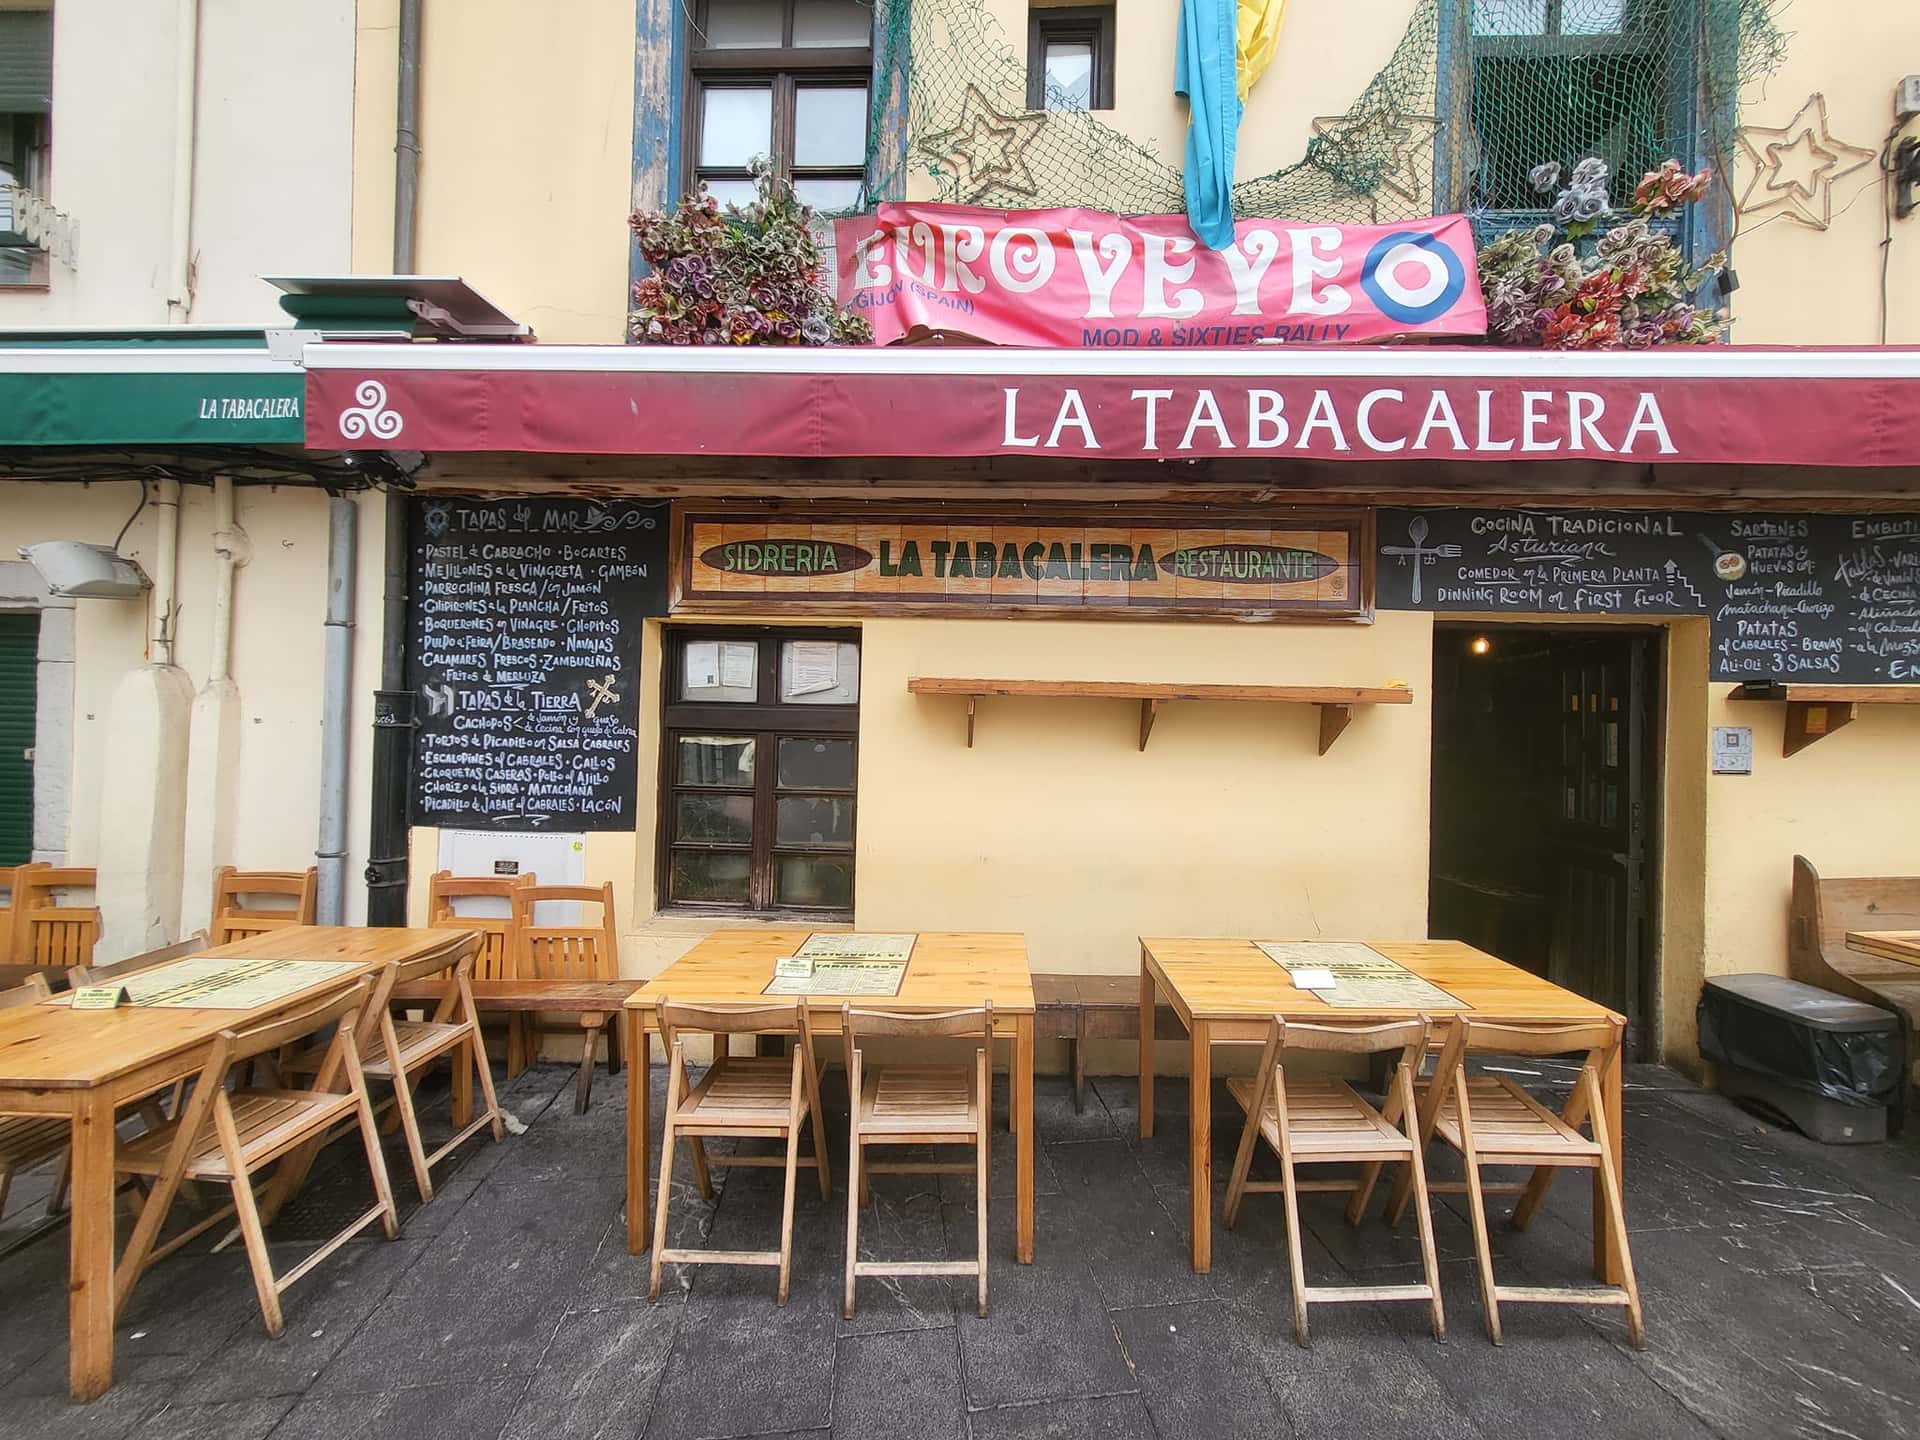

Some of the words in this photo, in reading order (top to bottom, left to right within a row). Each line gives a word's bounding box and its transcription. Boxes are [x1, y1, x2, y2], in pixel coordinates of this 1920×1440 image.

[1083, 328, 1139, 347] MOD
[1149, 328, 1163, 347] &
[1171, 325, 1265, 347] SIXTIES
[1273, 323, 1351, 342] RALLY
[200, 398, 217, 419] LA
[221, 397, 300, 419] TABACALERA
[1001, 387, 1102, 450] LA
[1131, 387, 1679, 455] TABACALERA
[456, 508, 506, 530] TAPAS
[543, 508, 581, 530] MAR
[1471, 513, 1536, 536] COCINA
[1546, 515, 1683, 537] TRADICIONAL
[426, 544, 468, 560] PASTEL
[482, 544, 551, 560] CABRACHO
[723, 543, 839, 572] SIDRERIA
[879, 540, 923, 578] LA
[930, 540, 1158, 581] TABACALERA
[1747, 544, 1795, 559] PATATAS
[425, 562, 493, 579] MEJILLONES
[1173, 549, 1314, 579] RESTAURANTE
[1458, 567, 1521, 580] COMEDOR
[1552, 566, 1607, 584] PRIMERA
[1613, 566, 1660, 583] PLANTA
[1500, 587, 1543, 608] ROOM
[425, 617, 494, 633] BOQUERONES
[1736, 620, 1798, 637] PATATAS
[1731, 639, 1788, 652] CABRALES
[1802, 637, 1843, 653] BRAVAS
[422, 652, 487, 668] CALAMARES
[494, 653, 537, 669] FRESCOS
[1771, 653, 1783, 672] 3
[1787, 653, 1840, 673] SALSAS
[458, 690, 501, 710] TAPAS
[531, 691, 582, 712] TIERRA
[453, 715, 513, 732] CACHOPOS
